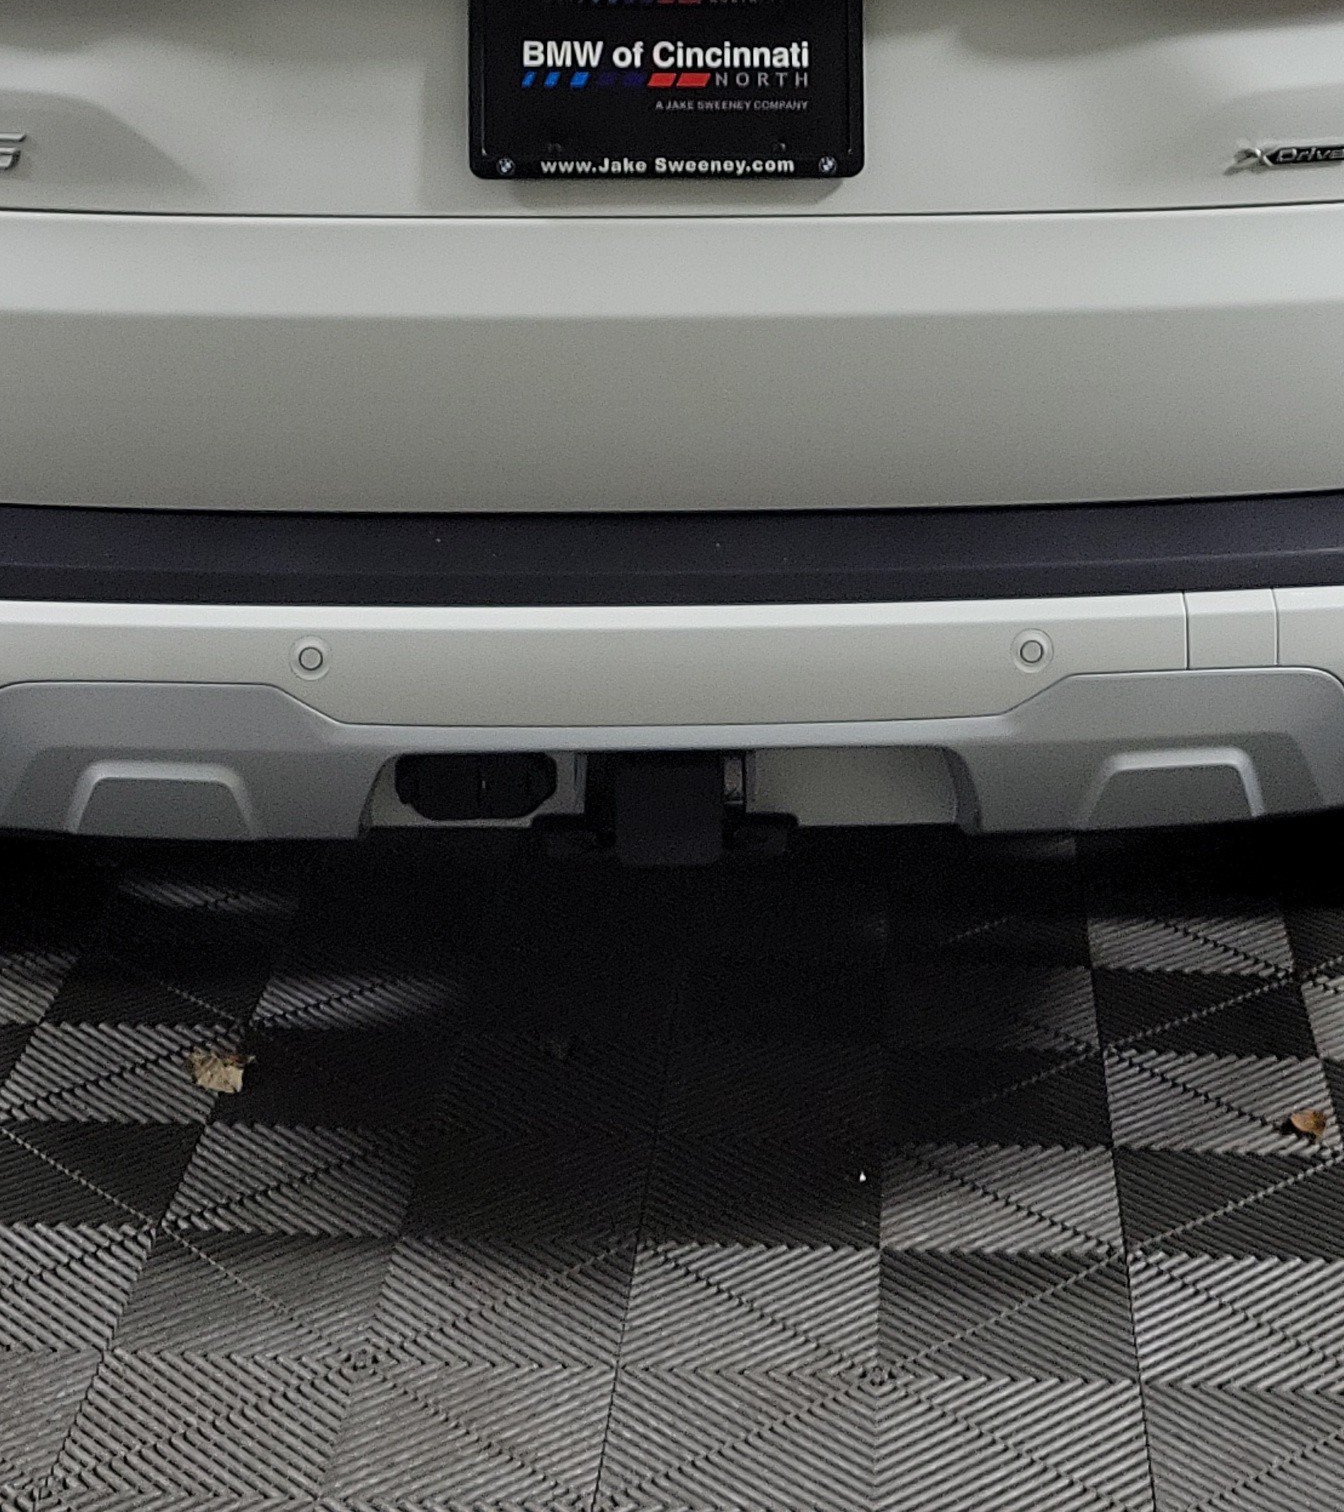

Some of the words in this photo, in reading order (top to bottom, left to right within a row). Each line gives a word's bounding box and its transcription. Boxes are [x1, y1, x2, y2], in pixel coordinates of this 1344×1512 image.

[522, 41, 603, 67] BMW
[612, 40, 644, 69] of
[653, 40, 809, 68] Cincinnati
[715, 72, 809, 87] NORTH
[656, 101, 664, 110] A
[666, 101, 693, 110] JAKE
[697, 101, 751, 110] SWEENEY
[753, 101, 809, 110] COMPANY
[540, 157, 648, 174] www.Jake
[655, 157, 795, 176] Sweeney.com
